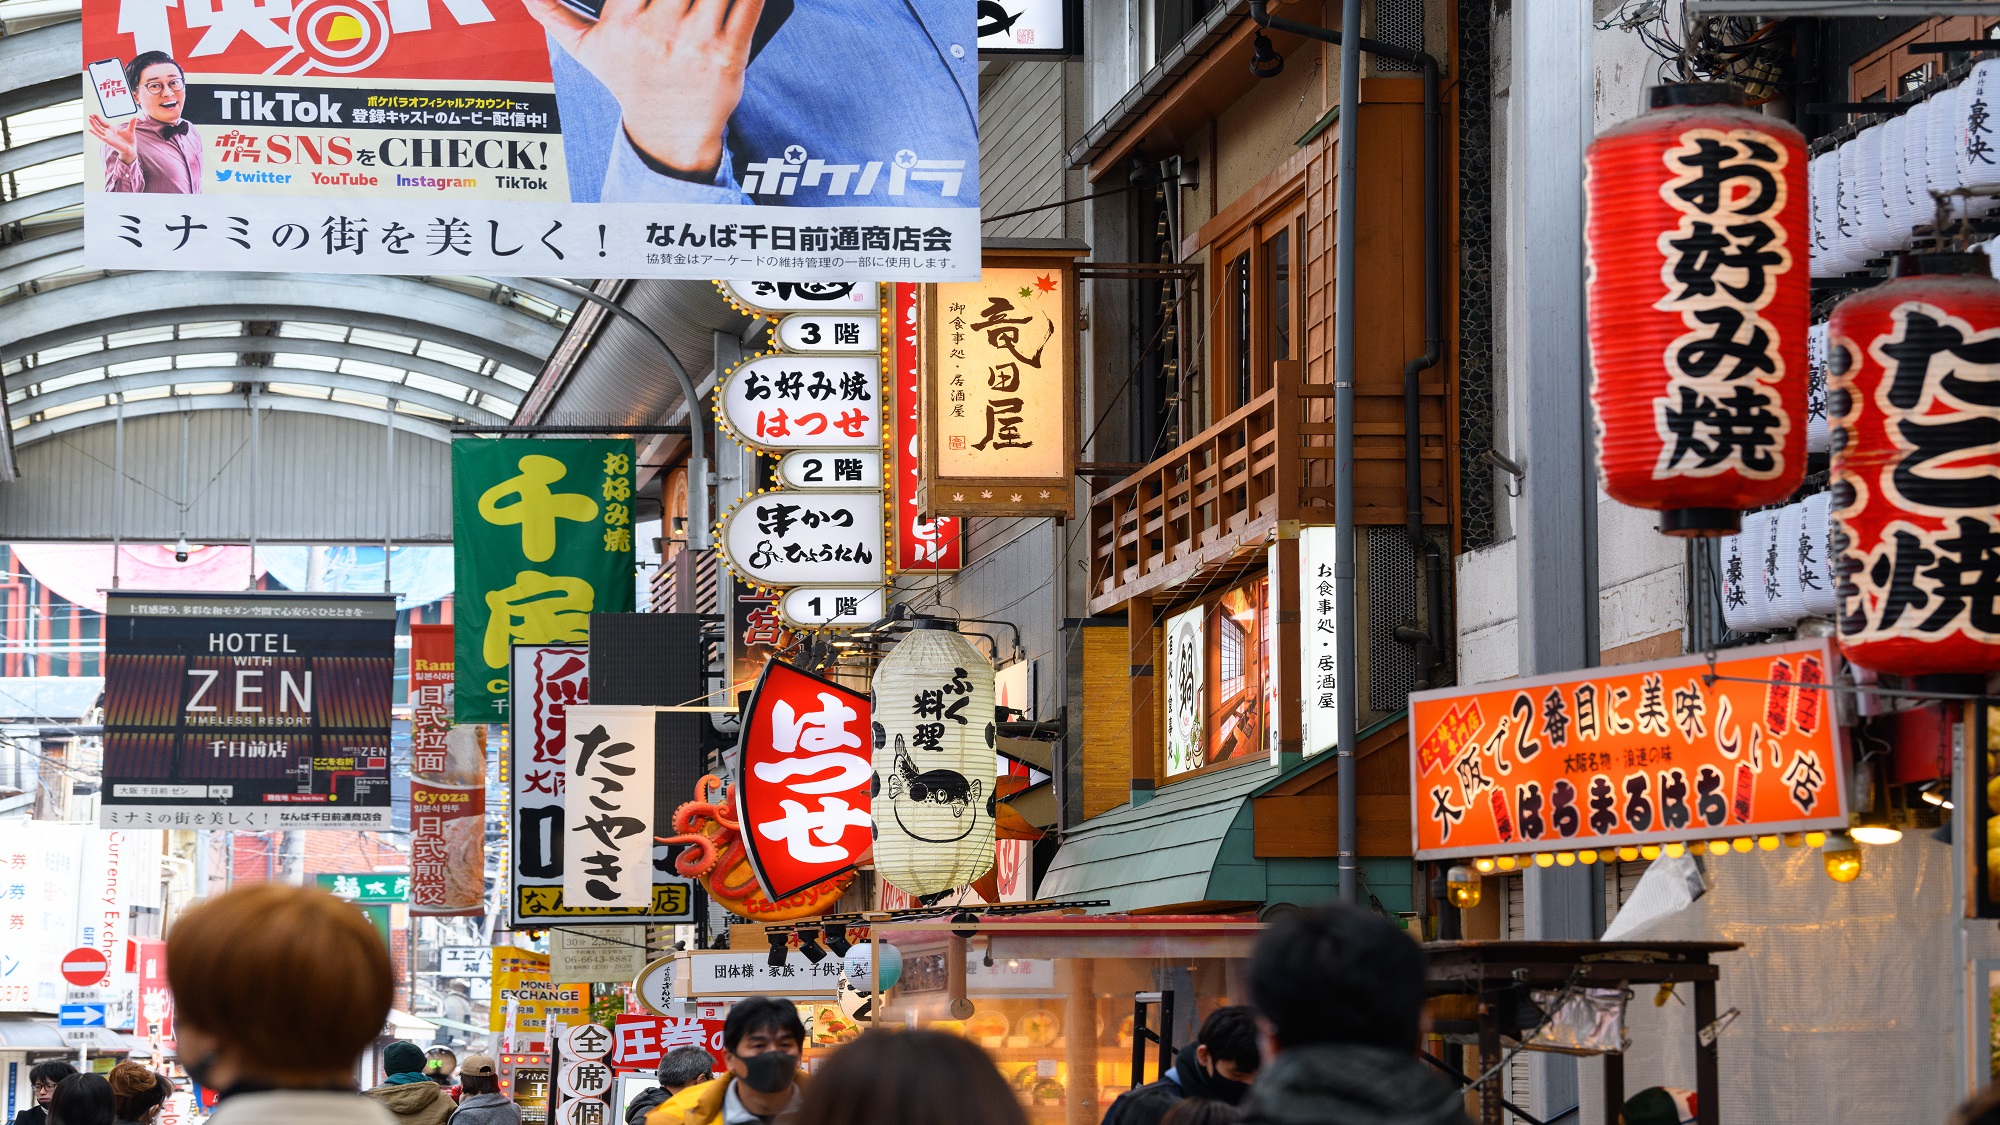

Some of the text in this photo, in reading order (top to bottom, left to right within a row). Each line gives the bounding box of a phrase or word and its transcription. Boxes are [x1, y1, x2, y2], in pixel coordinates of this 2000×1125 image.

[214, 90, 342, 123] TikTok
[352, 108, 548, 128] 登録キャストのムービー配信中!
[367, 95, 529, 111] ポケパラオフィシャルアカウントにて
[235, 170, 548, 191] twitter YouTube Instagram TikTok
[741, 144, 967, 197] ポケパラ
[646, 221, 953, 253] なんば千日前通商店会
[646, 253, 958, 270] 協賛金はアーケードの維持管理の一部に使用します。
[1659, 138, 1784, 473] お好み焼
[949, 302, 967, 418] 御食事処・居酒屋
[970, 296, 1055, 452] 竜田屋
[744, 370, 871, 402] お好み焼
[756, 407, 870, 439] はつせ
[602, 452, 631, 553] お好み焼
[756, 503, 854, 539] 串かつ
[783, 541, 873, 566] ひょうたん
[209, 632, 297, 653] HOTEL
[1316, 563, 1336, 709] お食事処・居酒屋
[233, 656, 272, 667] WITH
[185, 669, 313, 713] ZEN
[184, 715, 313, 726] TIMELESS RESORT
[416, 684, 447, 772] 日式拉面
[911, 688, 946, 752] 料理
[207, 740, 289, 759] 千日前店
[361, 746, 388, 756] ZEN
[753, 691, 871, 863] はつせ
[413, 789, 470, 804] Gyoza
[572, 724, 647, 901] たこやき
[1518, 768, 1726, 840] はちまるはち
[280, 812, 382, 822] なんば千日前通商店会
[501, 989, 579, 1001] EXCHANGE
[520, 980, 560, 990] MONEY
